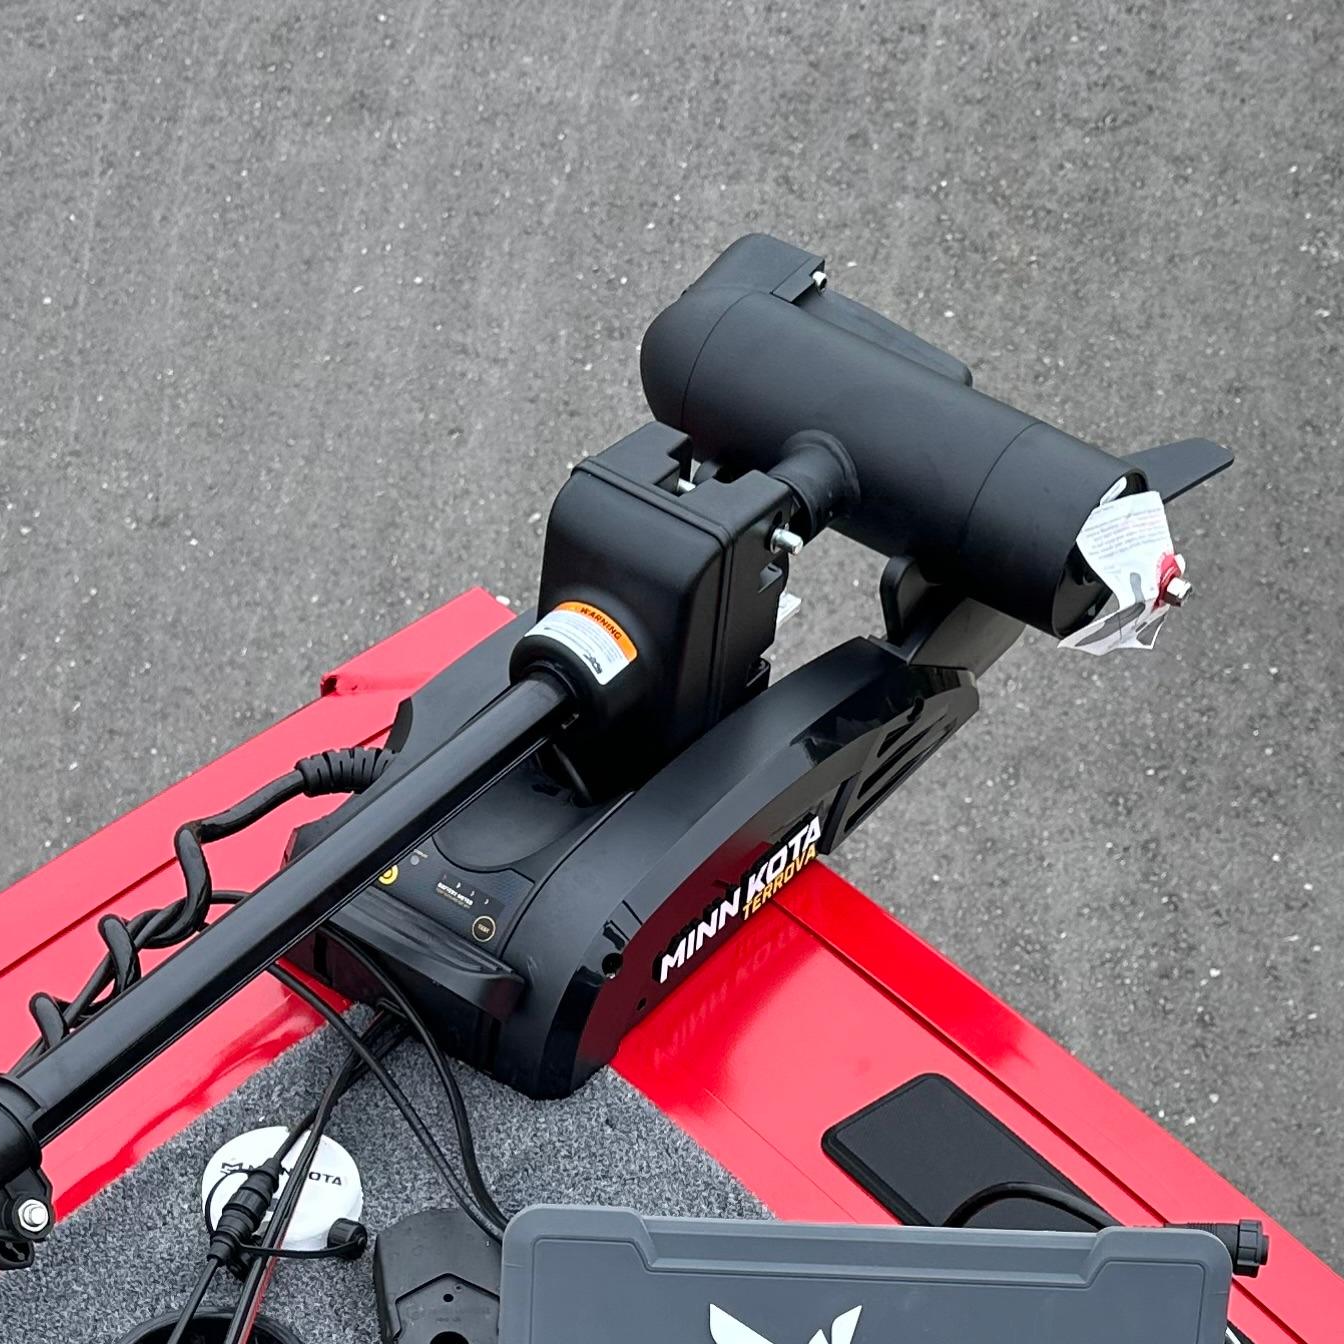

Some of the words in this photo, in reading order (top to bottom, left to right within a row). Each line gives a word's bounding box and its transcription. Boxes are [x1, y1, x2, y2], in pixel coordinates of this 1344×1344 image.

[580, 606, 623, 640] WARNING
[660, 886, 741, 984] MINN
[746, 815, 822, 904] KOTA
[742, 842, 817, 921] TERROVA
[308, 1171, 343, 1186] OTA
